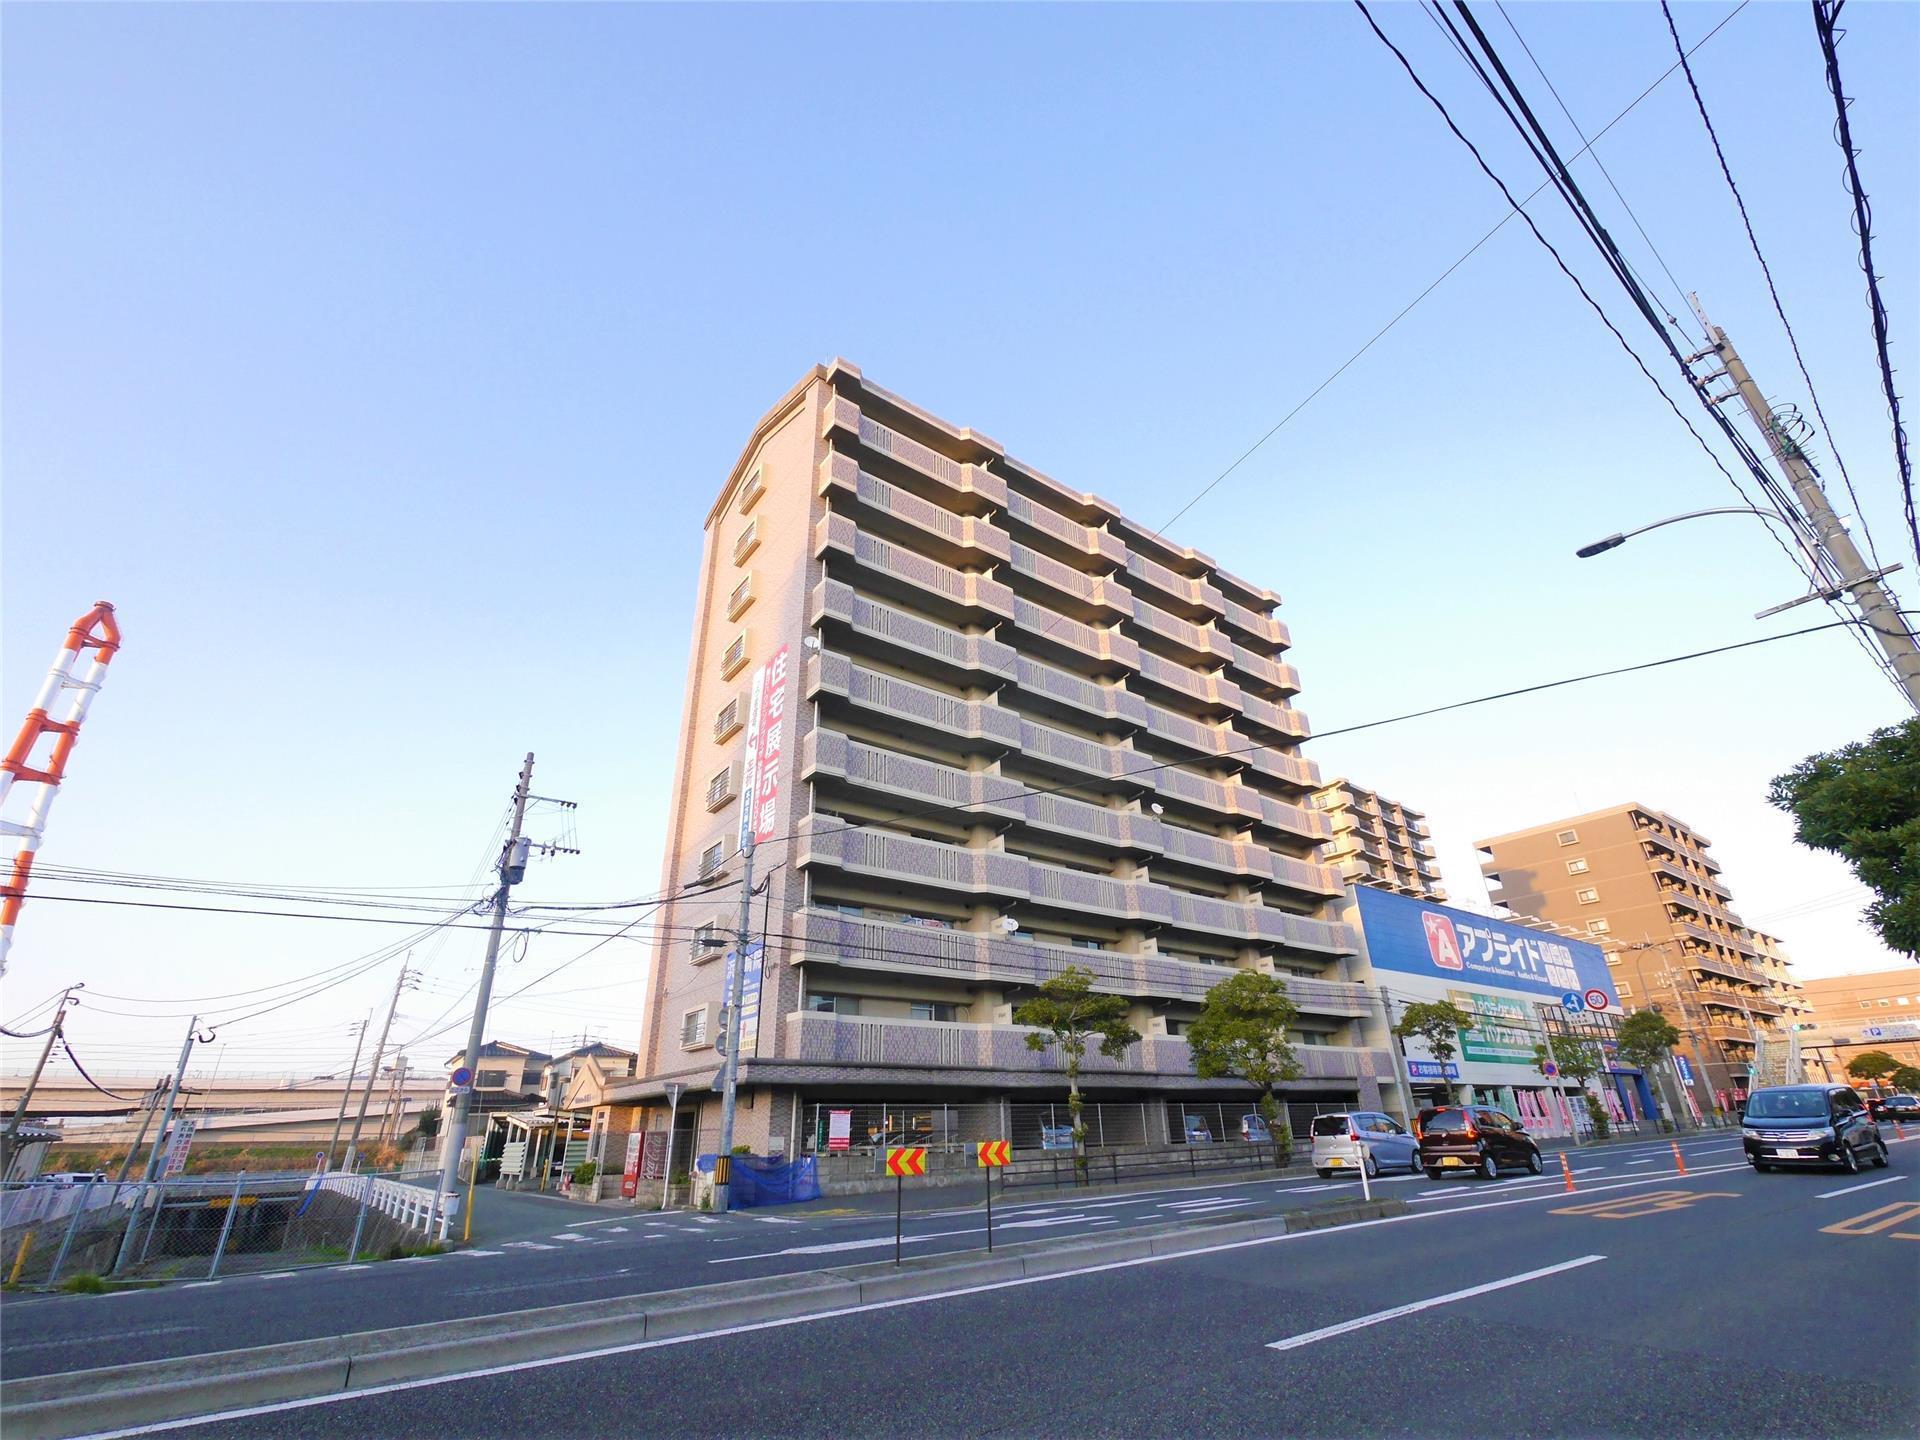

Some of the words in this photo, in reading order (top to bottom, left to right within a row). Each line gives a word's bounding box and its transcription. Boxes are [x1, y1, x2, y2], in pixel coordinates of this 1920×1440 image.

[760, 650, 788, 834] 住宅展示場
[1455, 923, 1540, 972] アプライド
